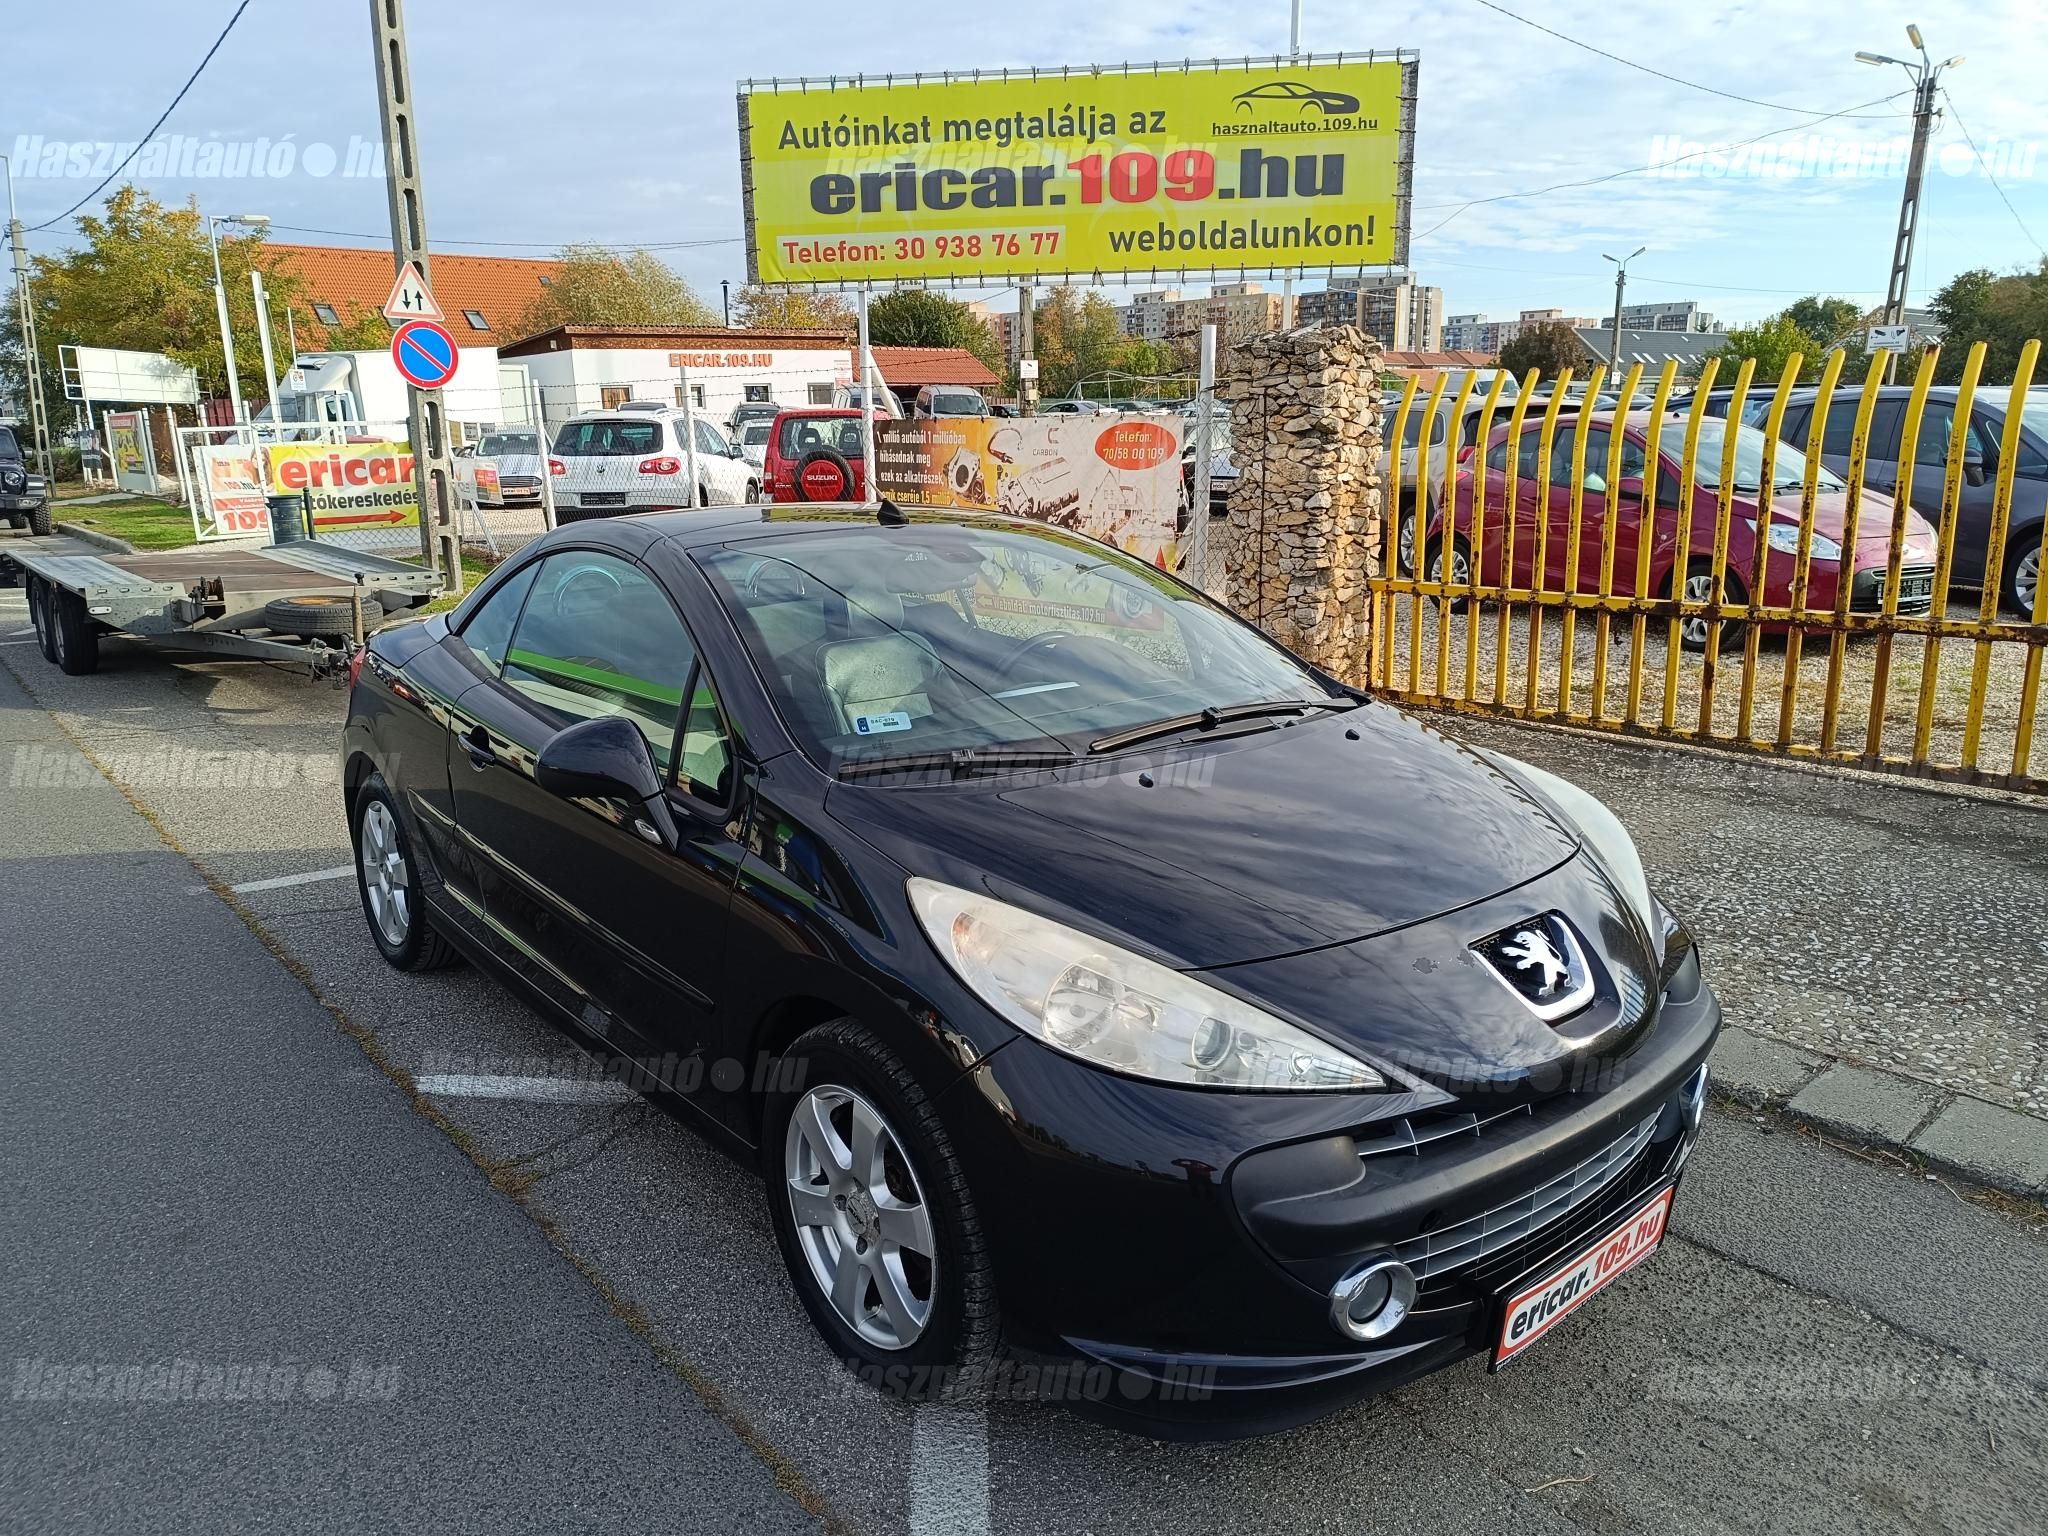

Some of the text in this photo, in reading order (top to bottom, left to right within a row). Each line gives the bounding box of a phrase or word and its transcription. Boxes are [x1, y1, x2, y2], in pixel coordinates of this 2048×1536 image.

[778, 102, 1166, 149] Autóinkat megtalálja az
[1211, 117, 1379, 137] hasznaltauto.109.hu
[809, 147, 1345, 215] ericar.109.hu
[782, 232, 1060, 264] Telefon: 30 938 76 77
[1109, 215, 1375, 252] weboldalunkon!
[669, 353, 773, 368] ERICAR.109.HU
[1115, 430, 1152, 443] Telefon:
[280, 454, 416, 489] ericar
[806, 474, 838, 482] SUZUKI
[1510, 1211, 1662, 1340] ericar.109.hu
